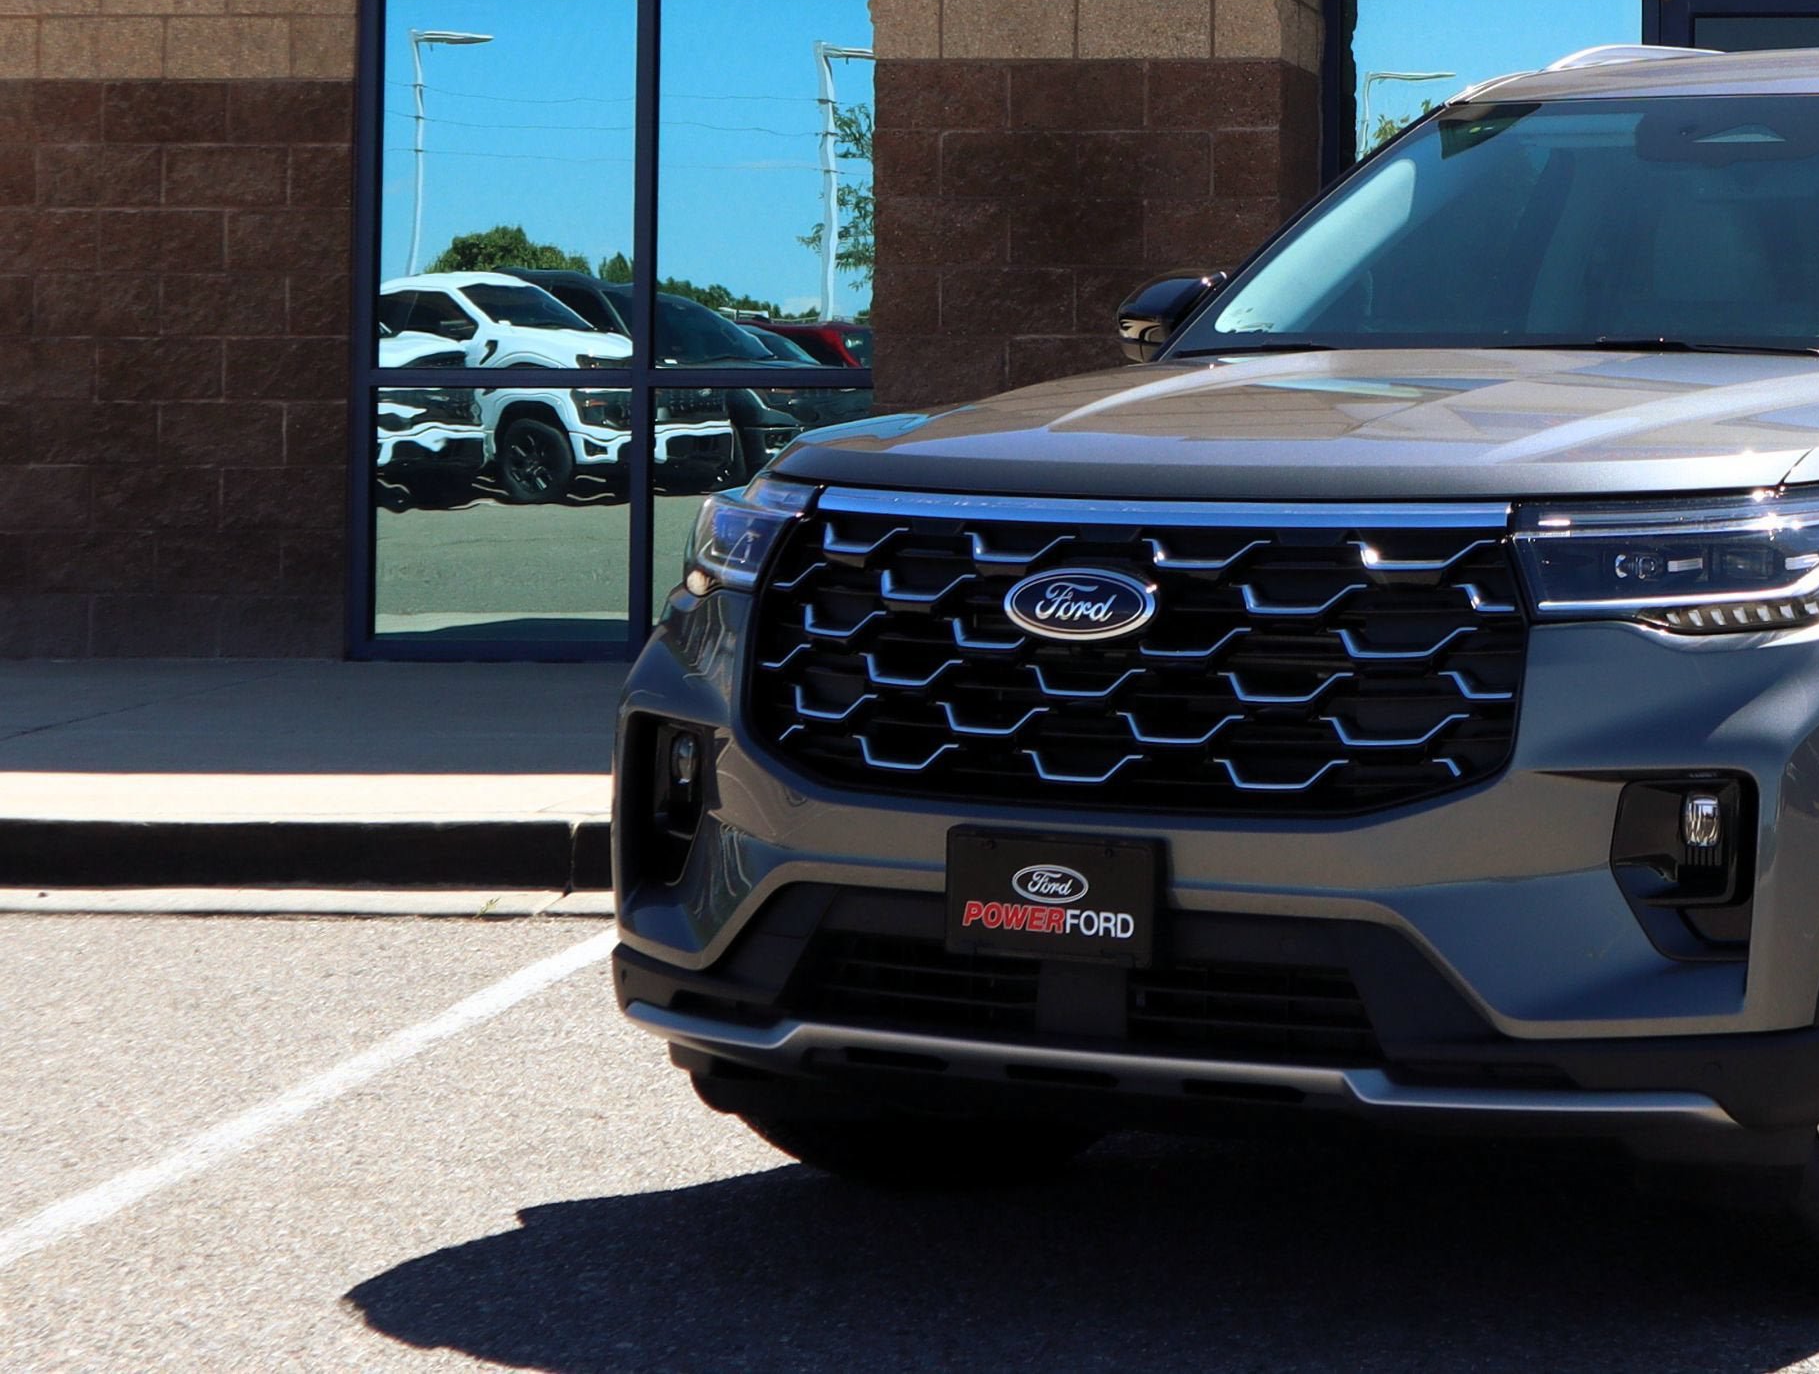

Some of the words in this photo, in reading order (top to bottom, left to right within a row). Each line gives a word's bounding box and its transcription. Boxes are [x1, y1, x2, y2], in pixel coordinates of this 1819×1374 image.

[1034, 581, 1116, 624] Ford
[1027, 874, 1073, 897] Ford
[962, 900, 1135, 939] POWERFORD
